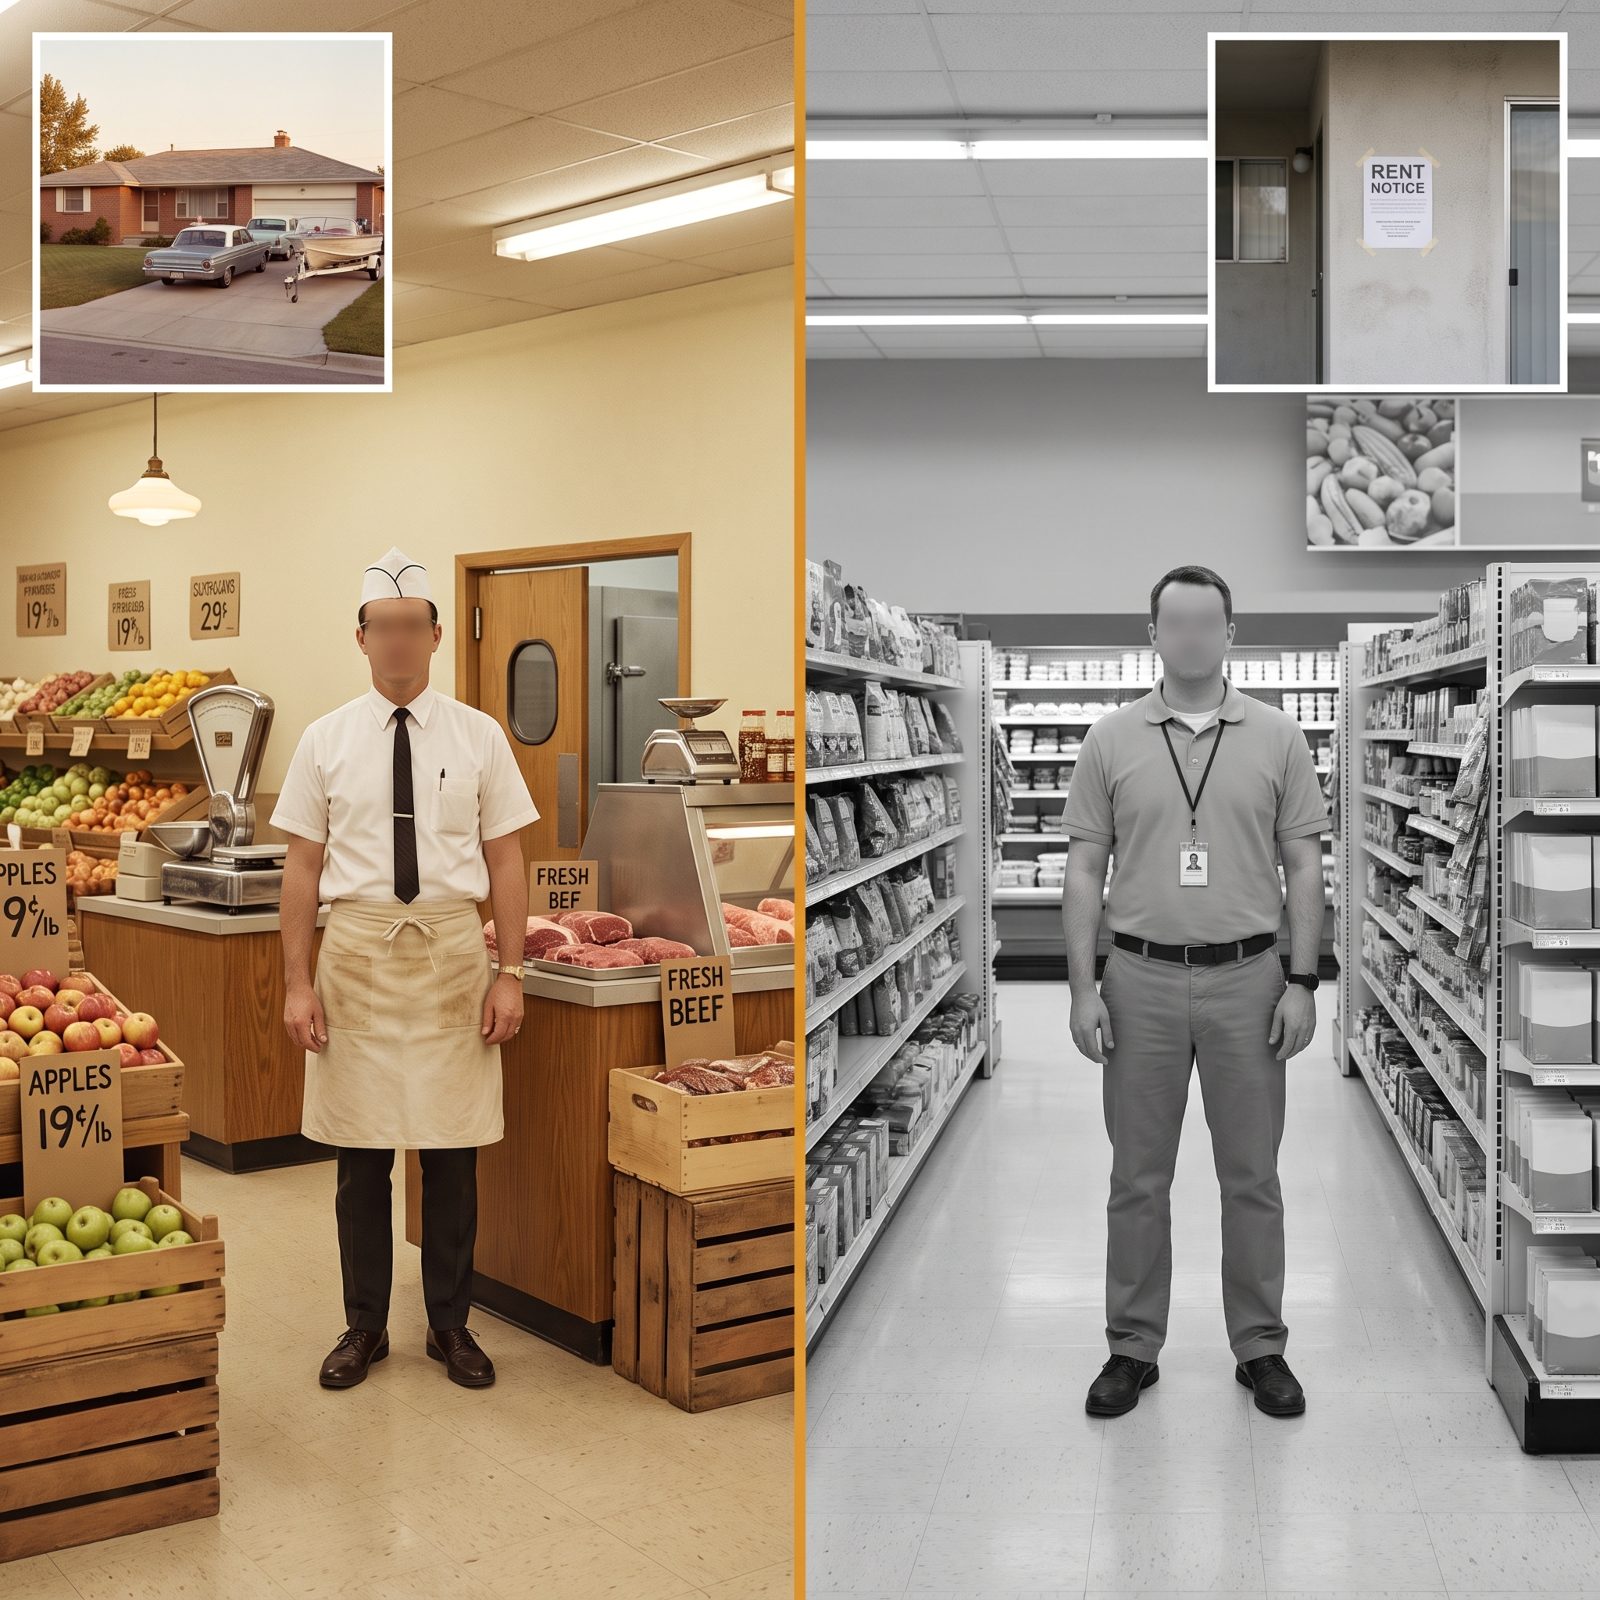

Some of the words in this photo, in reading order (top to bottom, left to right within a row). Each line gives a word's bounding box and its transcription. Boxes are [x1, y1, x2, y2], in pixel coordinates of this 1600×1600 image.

[1372, 164, 1425, 179] RENT
[1371, 182, 1425, 194] NOTICE
[537, 867, 589, 886] FRESH
[549, 891, 581, 909] BEF
[668, 966, 723, 991] FRESH
[670, 994, 725, 1027] BEEF
[28, 1063, 112, 1096] APPLES
[39, 1103, 112, 1150] 19¢/lb
